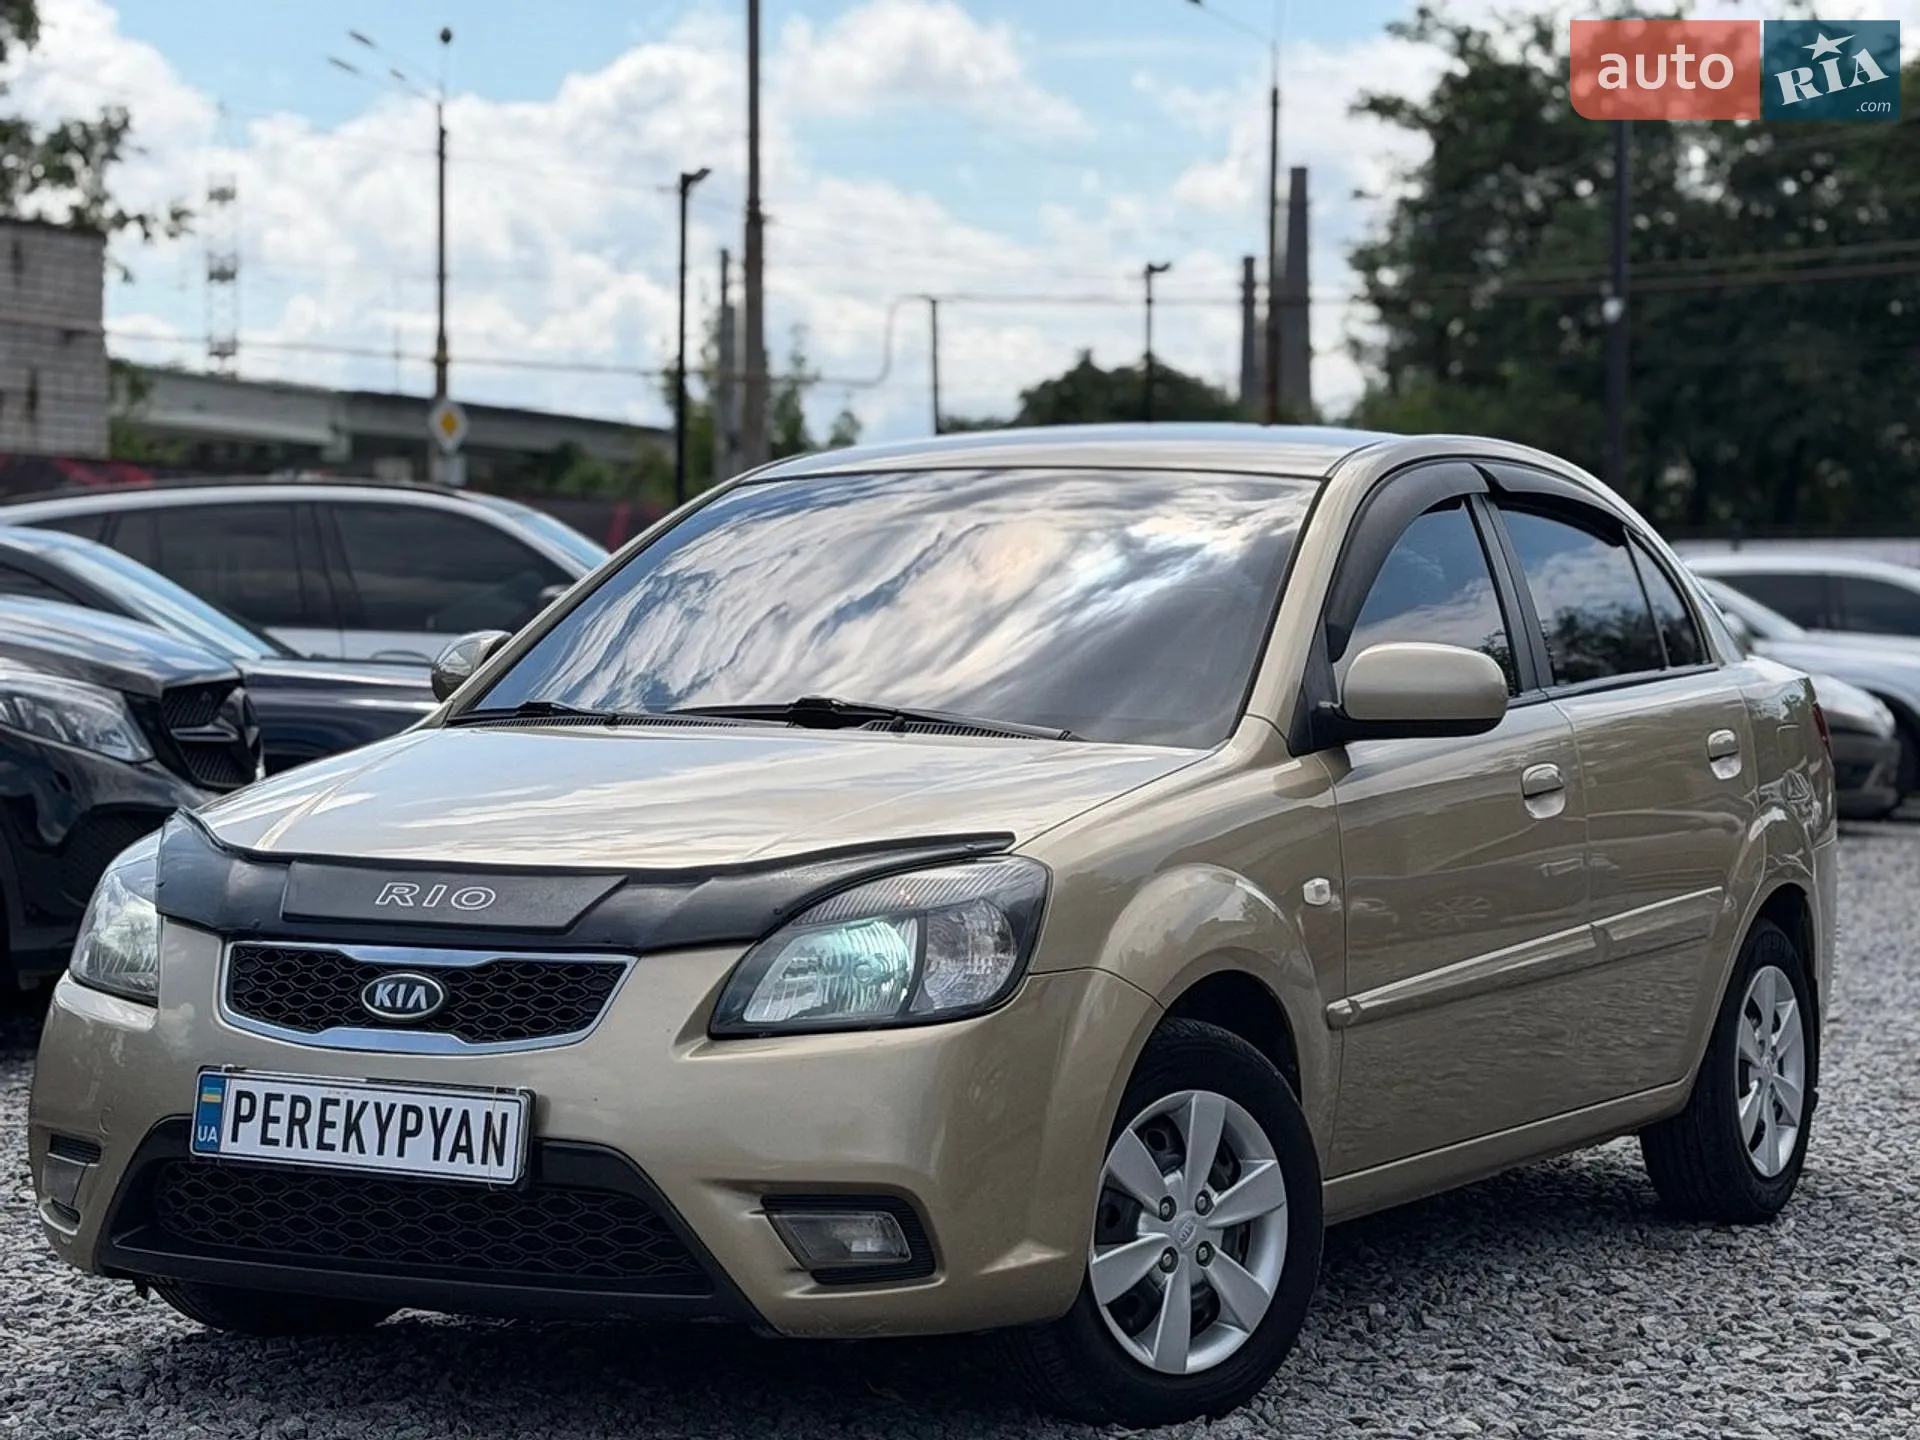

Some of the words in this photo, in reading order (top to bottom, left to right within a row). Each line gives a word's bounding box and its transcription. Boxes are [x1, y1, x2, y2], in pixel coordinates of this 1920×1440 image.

[375, 882, 496, 910] RIO
[374, 983, 428, 1010] KIA
[198, 1125, 218, 1144] UA
[230, 1090, 509, 1167] PEREKYPYAN
